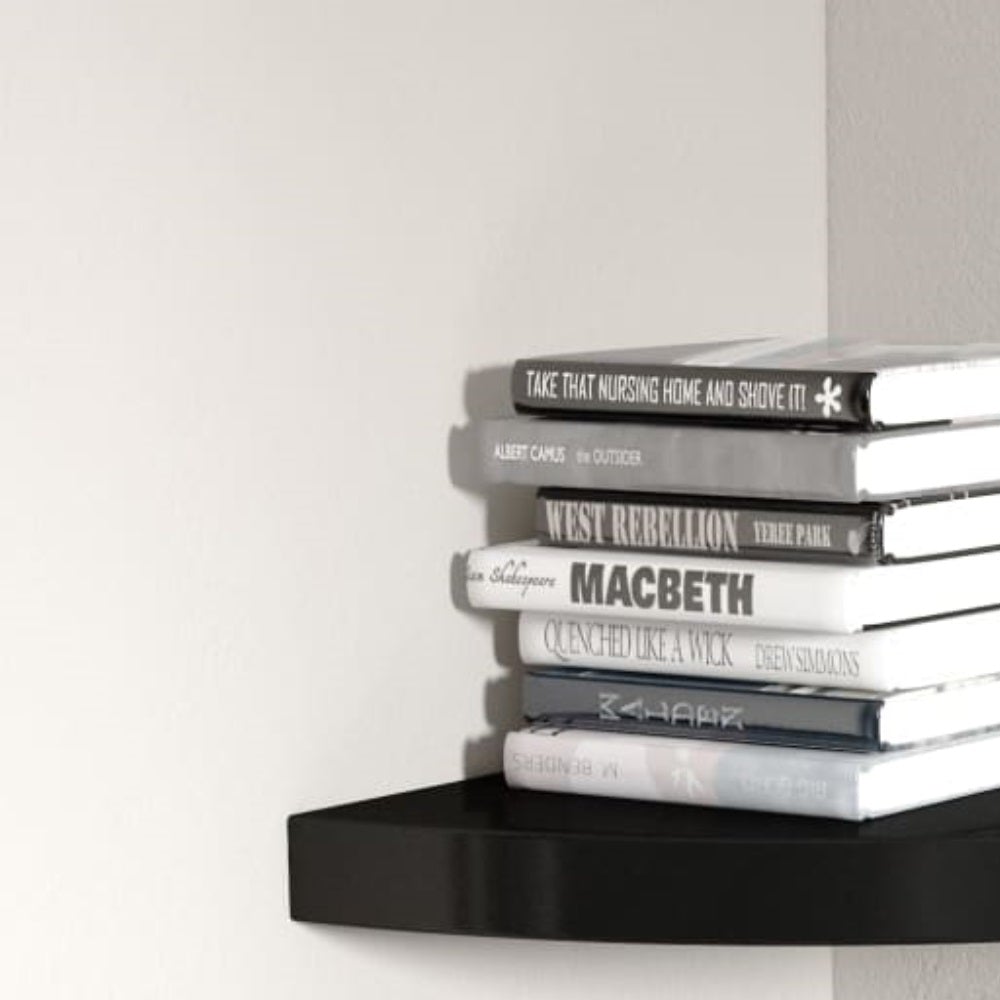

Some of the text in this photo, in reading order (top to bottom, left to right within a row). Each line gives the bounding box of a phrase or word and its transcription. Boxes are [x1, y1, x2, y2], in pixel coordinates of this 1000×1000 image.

[526, 370, 559, 399] TAKE
[562, 372, 596, 400] THAT
[599, 374, 659, 403] NURSING
[663, 377, 703, 406] HOME
[706, 379, 735, 407] AND
[738, 381, 785, 410] SHOVE
[494, 443, 527, 461] ALBERT
[530, 445, 566, 464] CAMUS
[592, 450, 641, 466] OUTSIDER
[546, 501, 738, 553] WEST REBELLION
[796, 523, 830, 547] PARK
[570, 562, 754, 616] MACBETH
[544, 618, 733, 667] QUENCHED LIKE A WICK
[796, 647, 860, 676] SIMMONS
